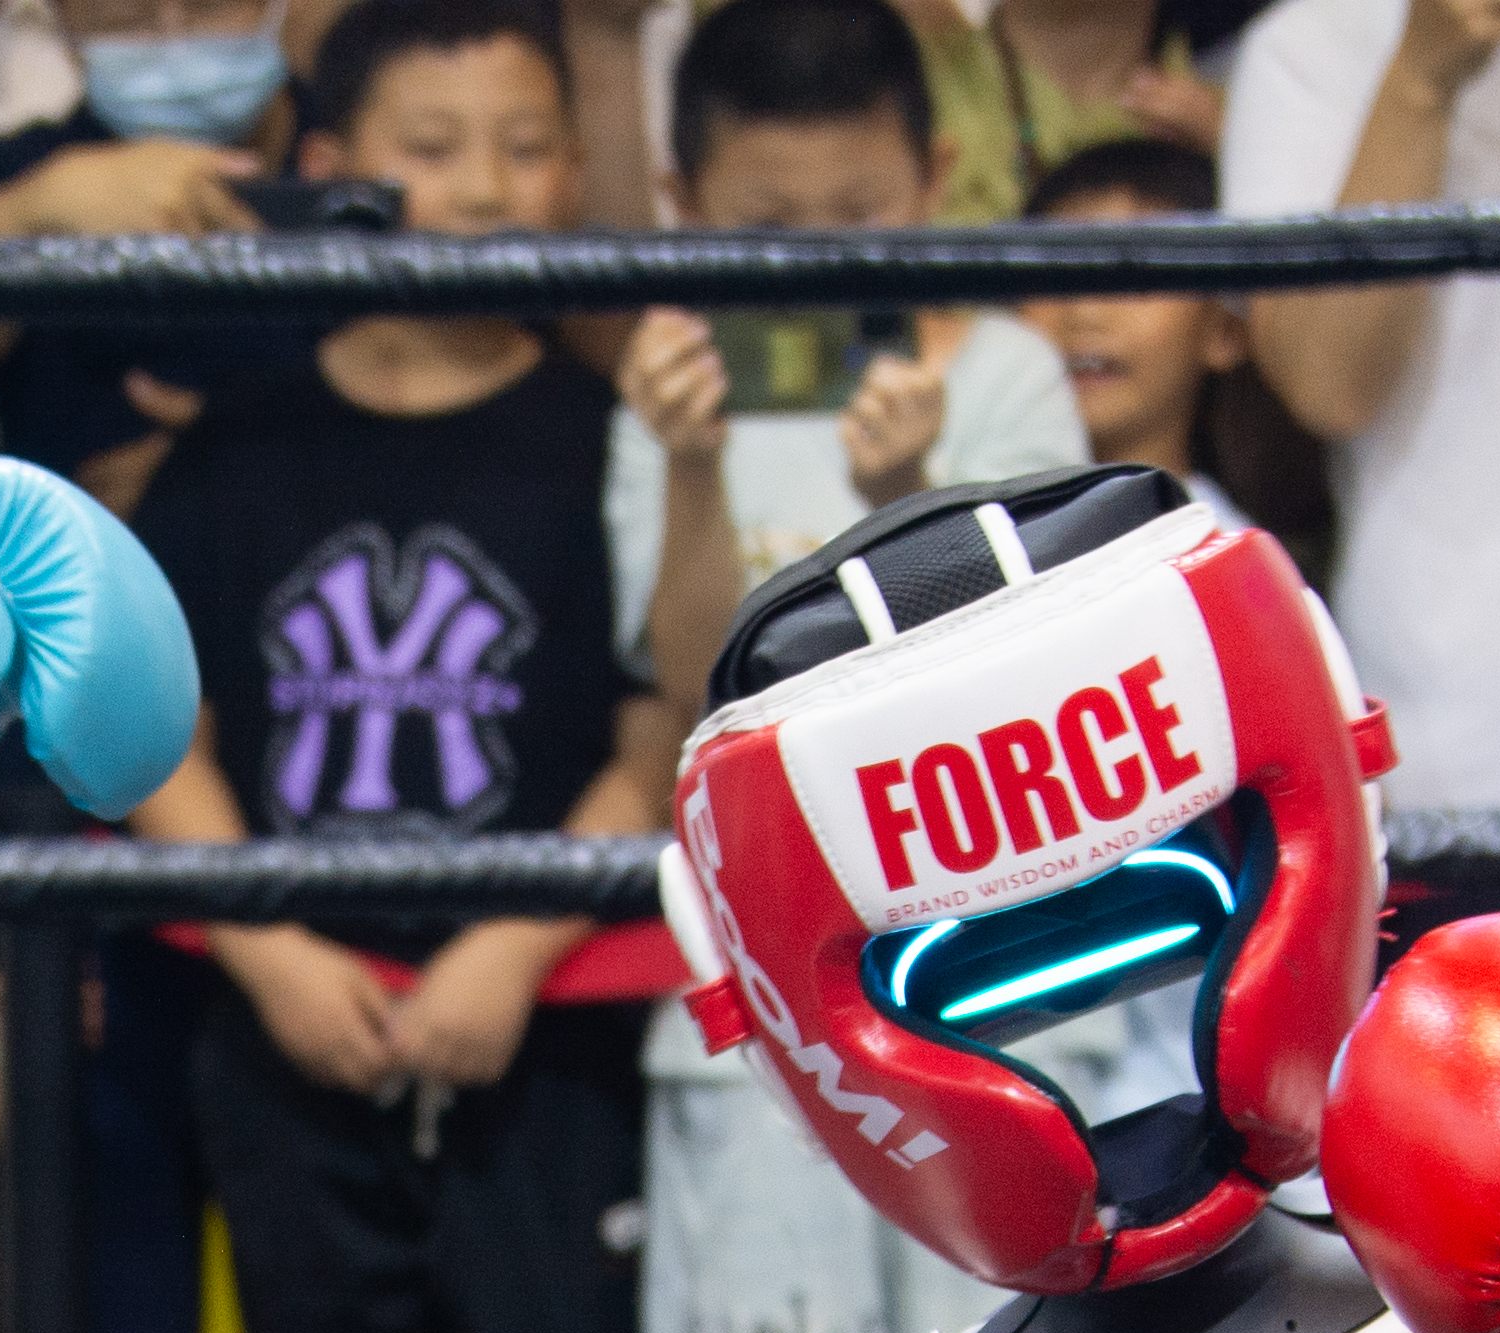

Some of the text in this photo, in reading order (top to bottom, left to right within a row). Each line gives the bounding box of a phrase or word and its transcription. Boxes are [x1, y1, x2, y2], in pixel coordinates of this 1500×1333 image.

[855, 653, 1204, 892] FORCE
[885, 785, 1221, 923] BRAND WISDOM AND CHARM
